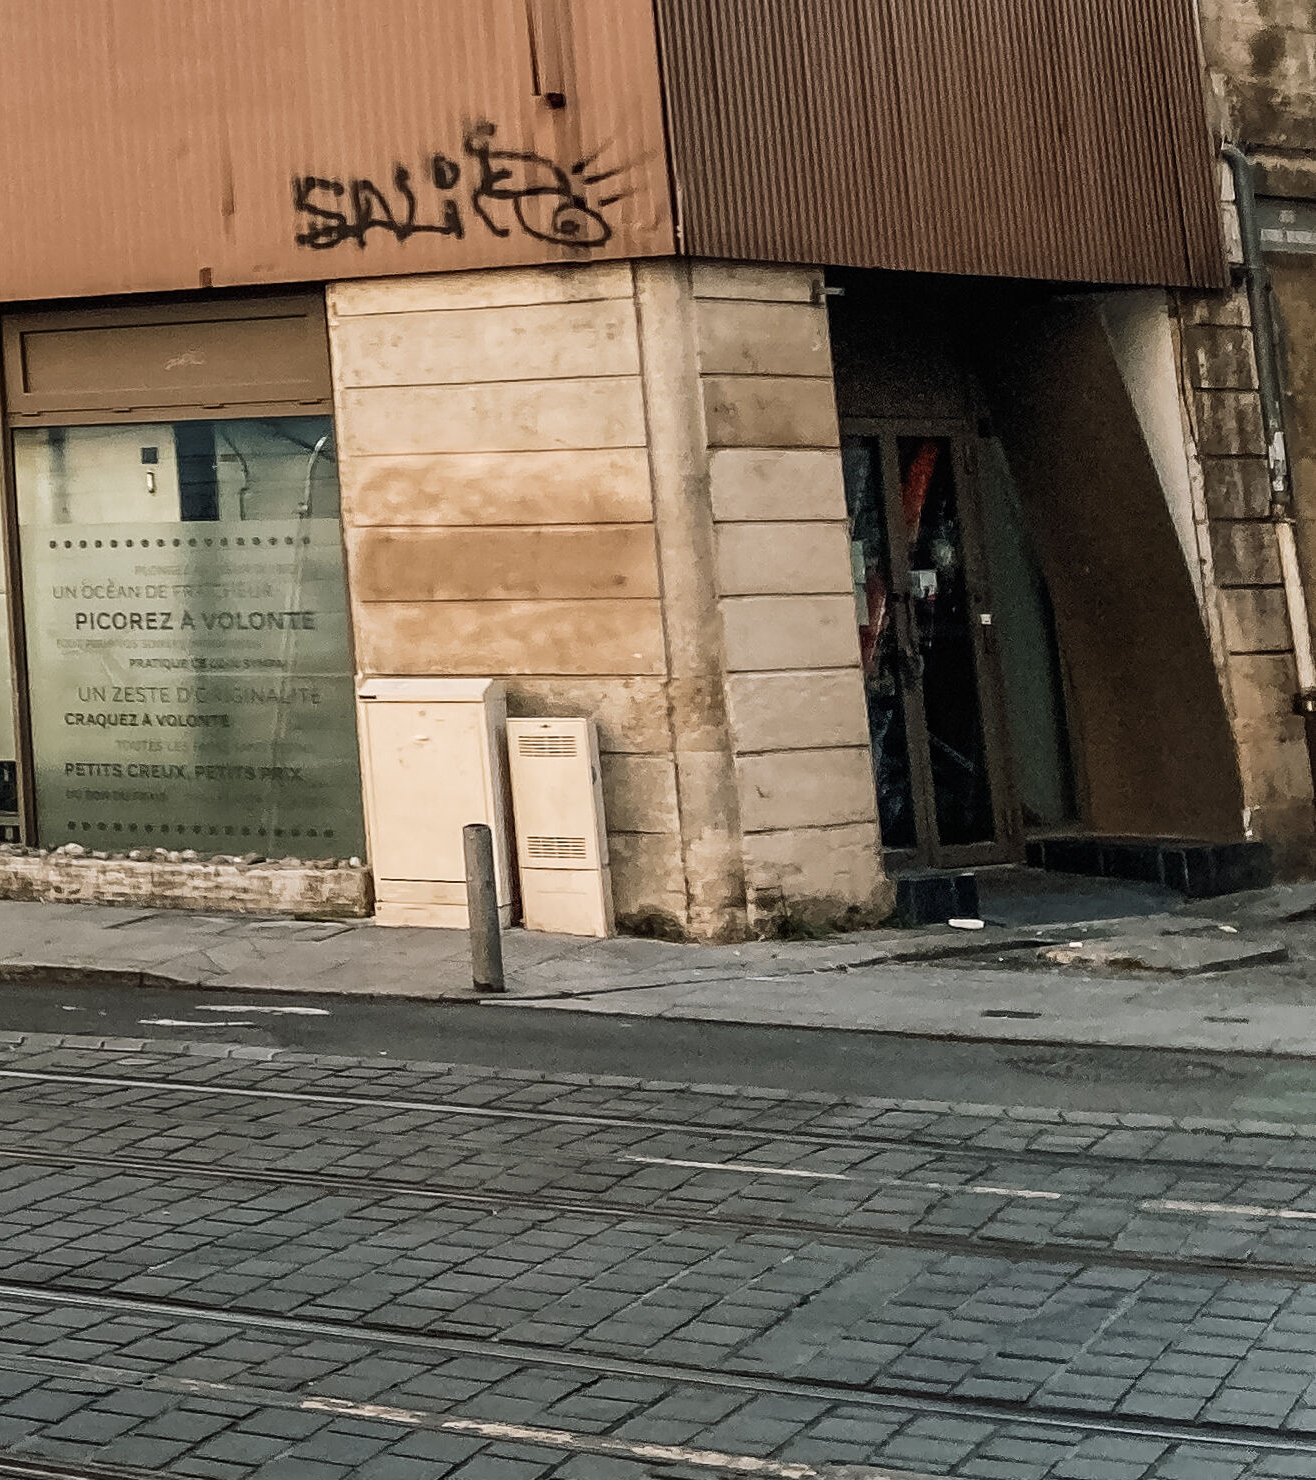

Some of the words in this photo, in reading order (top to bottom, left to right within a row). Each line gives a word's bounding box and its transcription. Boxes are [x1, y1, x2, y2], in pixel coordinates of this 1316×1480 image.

[144, 585, 168, 599] DE
[75, 611, 174, 631] PICOREZ
[78, 686, 106, 702] UN
[112, 686, 170, 703] ZESTE
[64, 712, 138, 728] CRAQUEZ
[65, 763, 122, 777] PETITS
